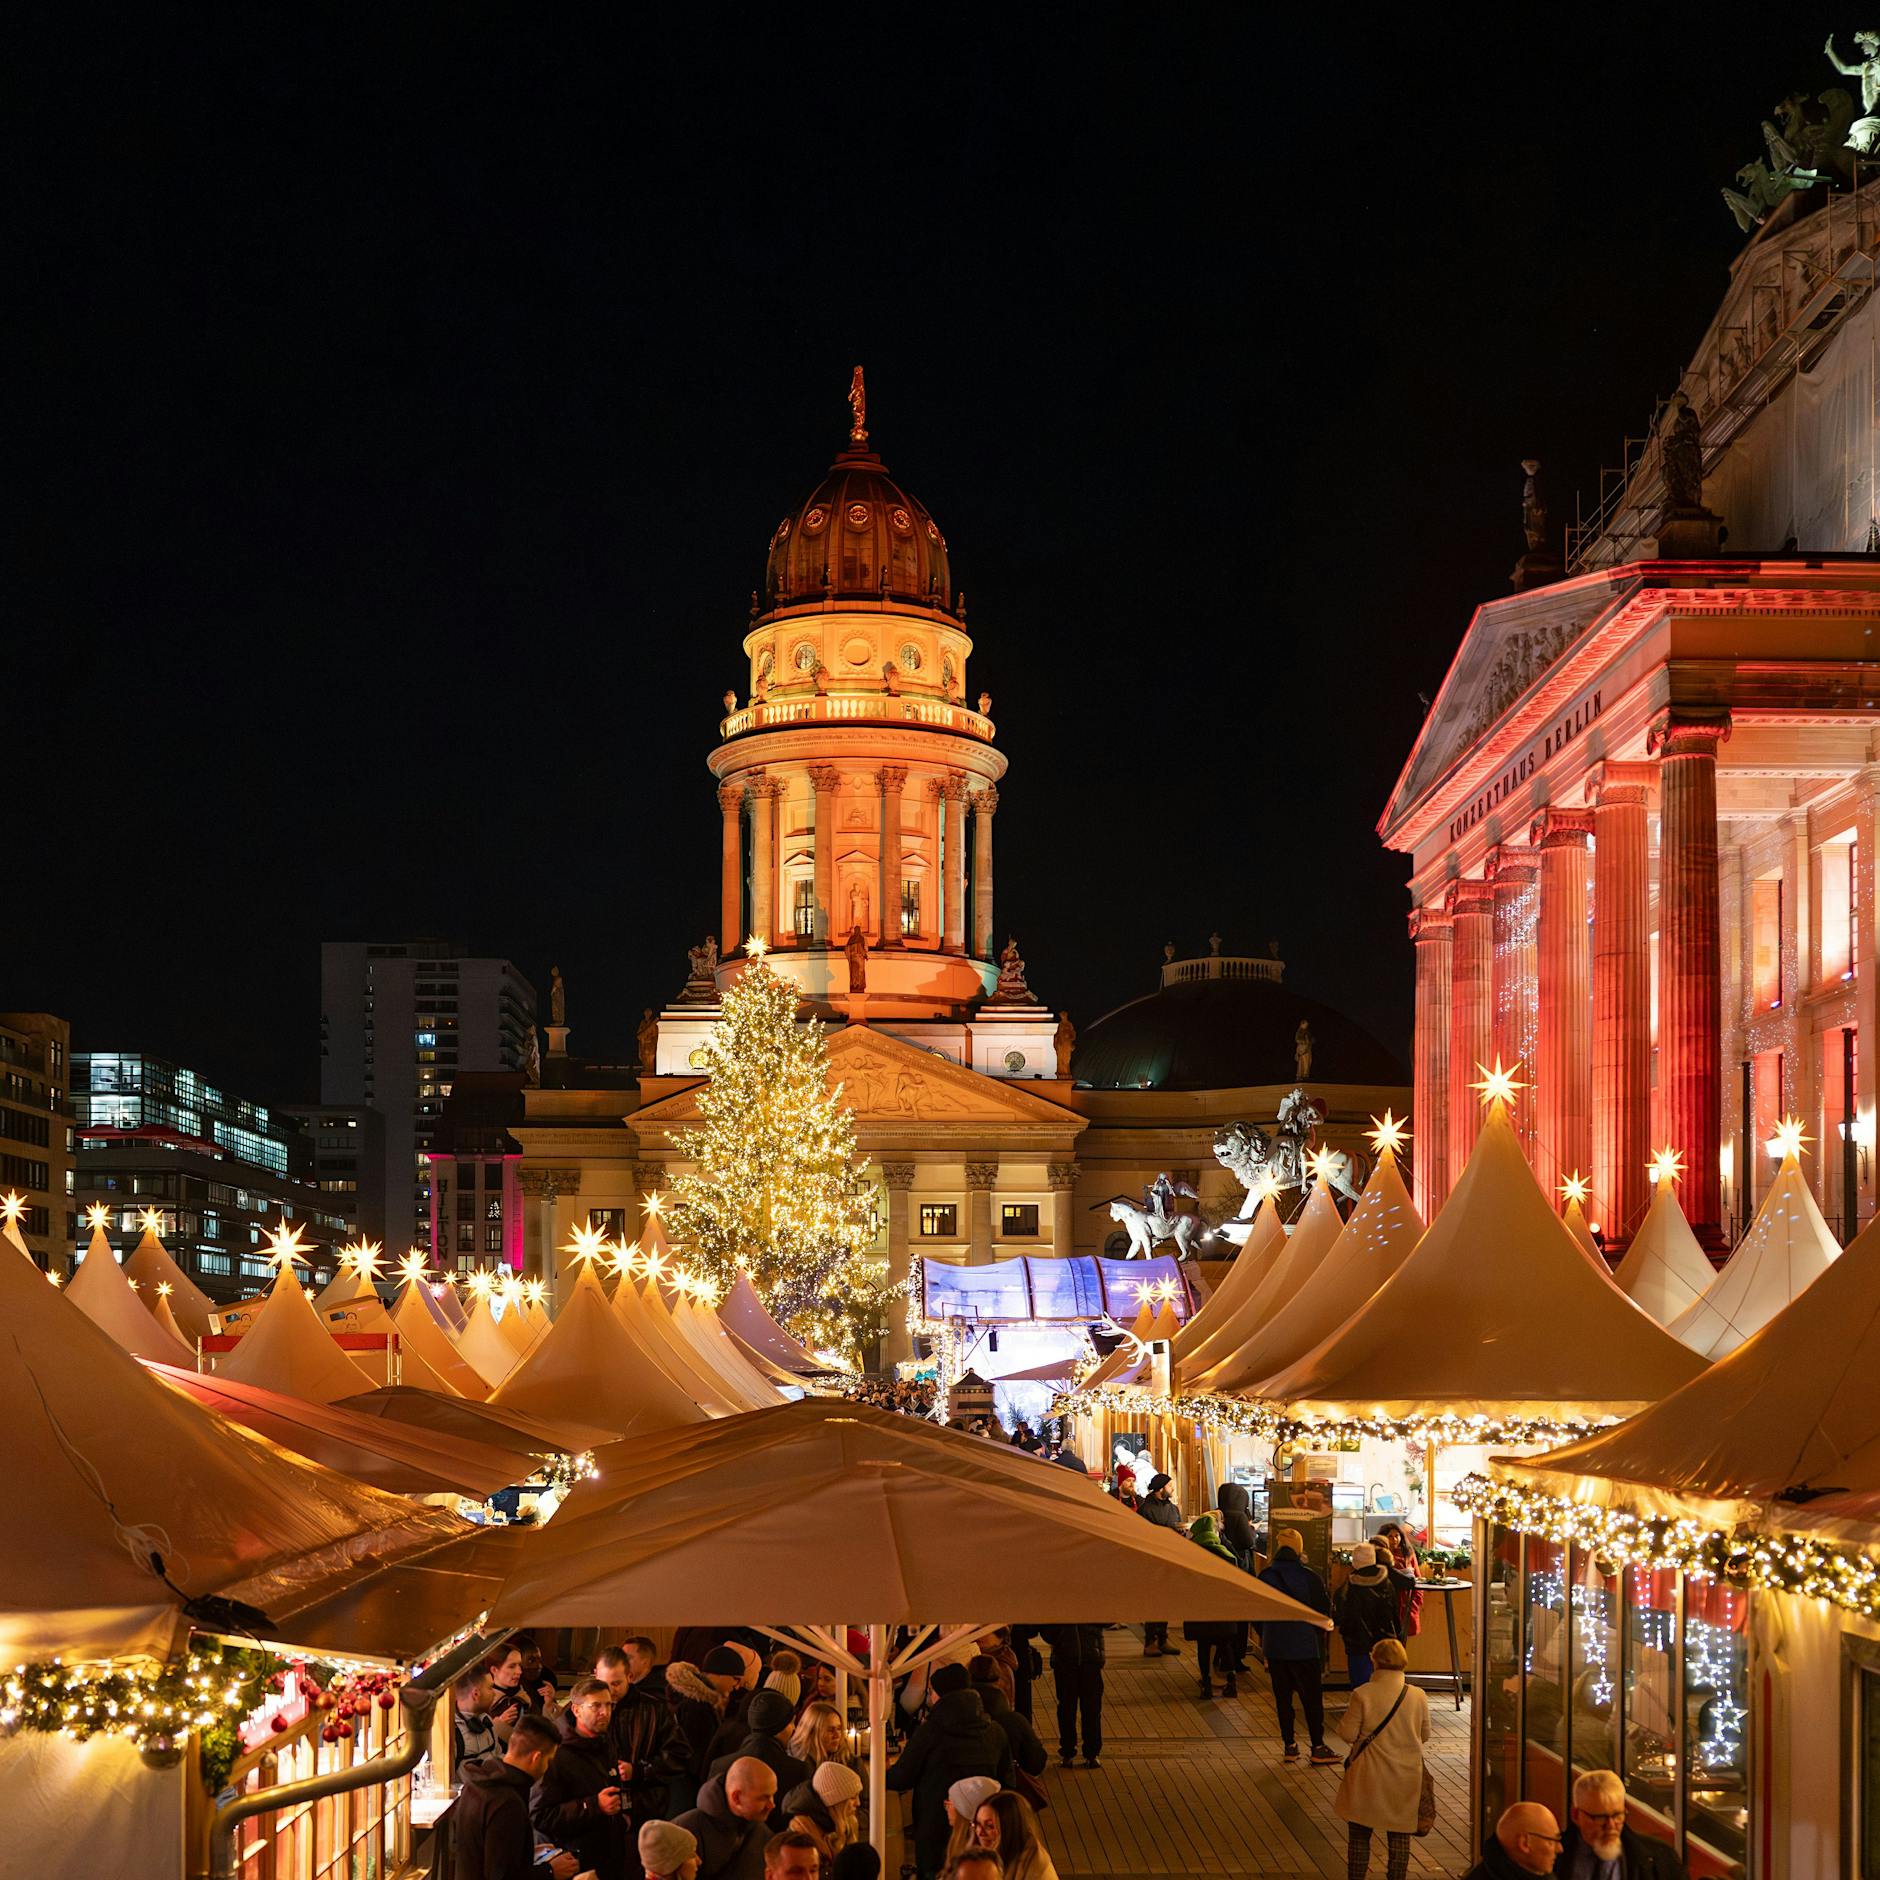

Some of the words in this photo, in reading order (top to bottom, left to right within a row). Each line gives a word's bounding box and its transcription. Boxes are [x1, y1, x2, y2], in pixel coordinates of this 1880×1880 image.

[1450, 752, 1535, 844] KONZERTHAUS
[1545, 690, 1602, 761] BERLIN
[437, 1179, 449, 1262] HILTON
